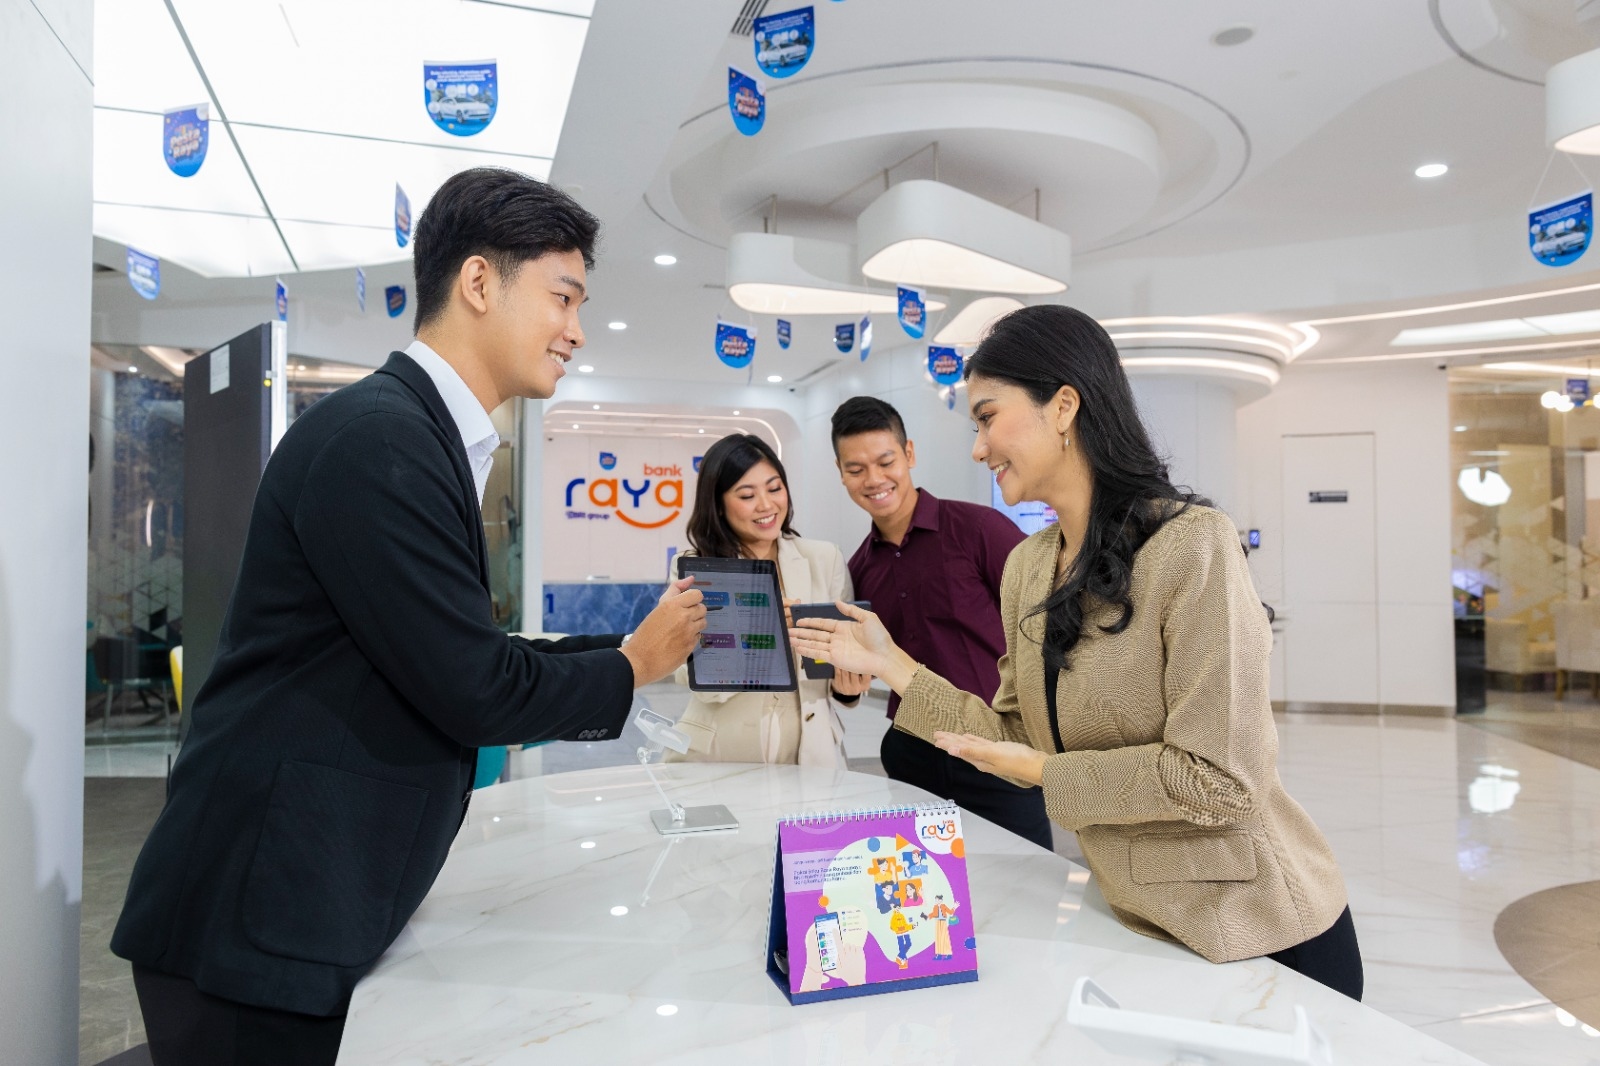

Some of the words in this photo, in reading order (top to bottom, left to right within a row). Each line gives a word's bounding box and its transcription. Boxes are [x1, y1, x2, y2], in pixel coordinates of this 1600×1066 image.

[643, 463, 683, 476] bank
[565, 478, 683, 508] raya
[587, 512, 610, 520] group
[545, 593, 554, 614] 1
[921, 823, 956, 836] raya
